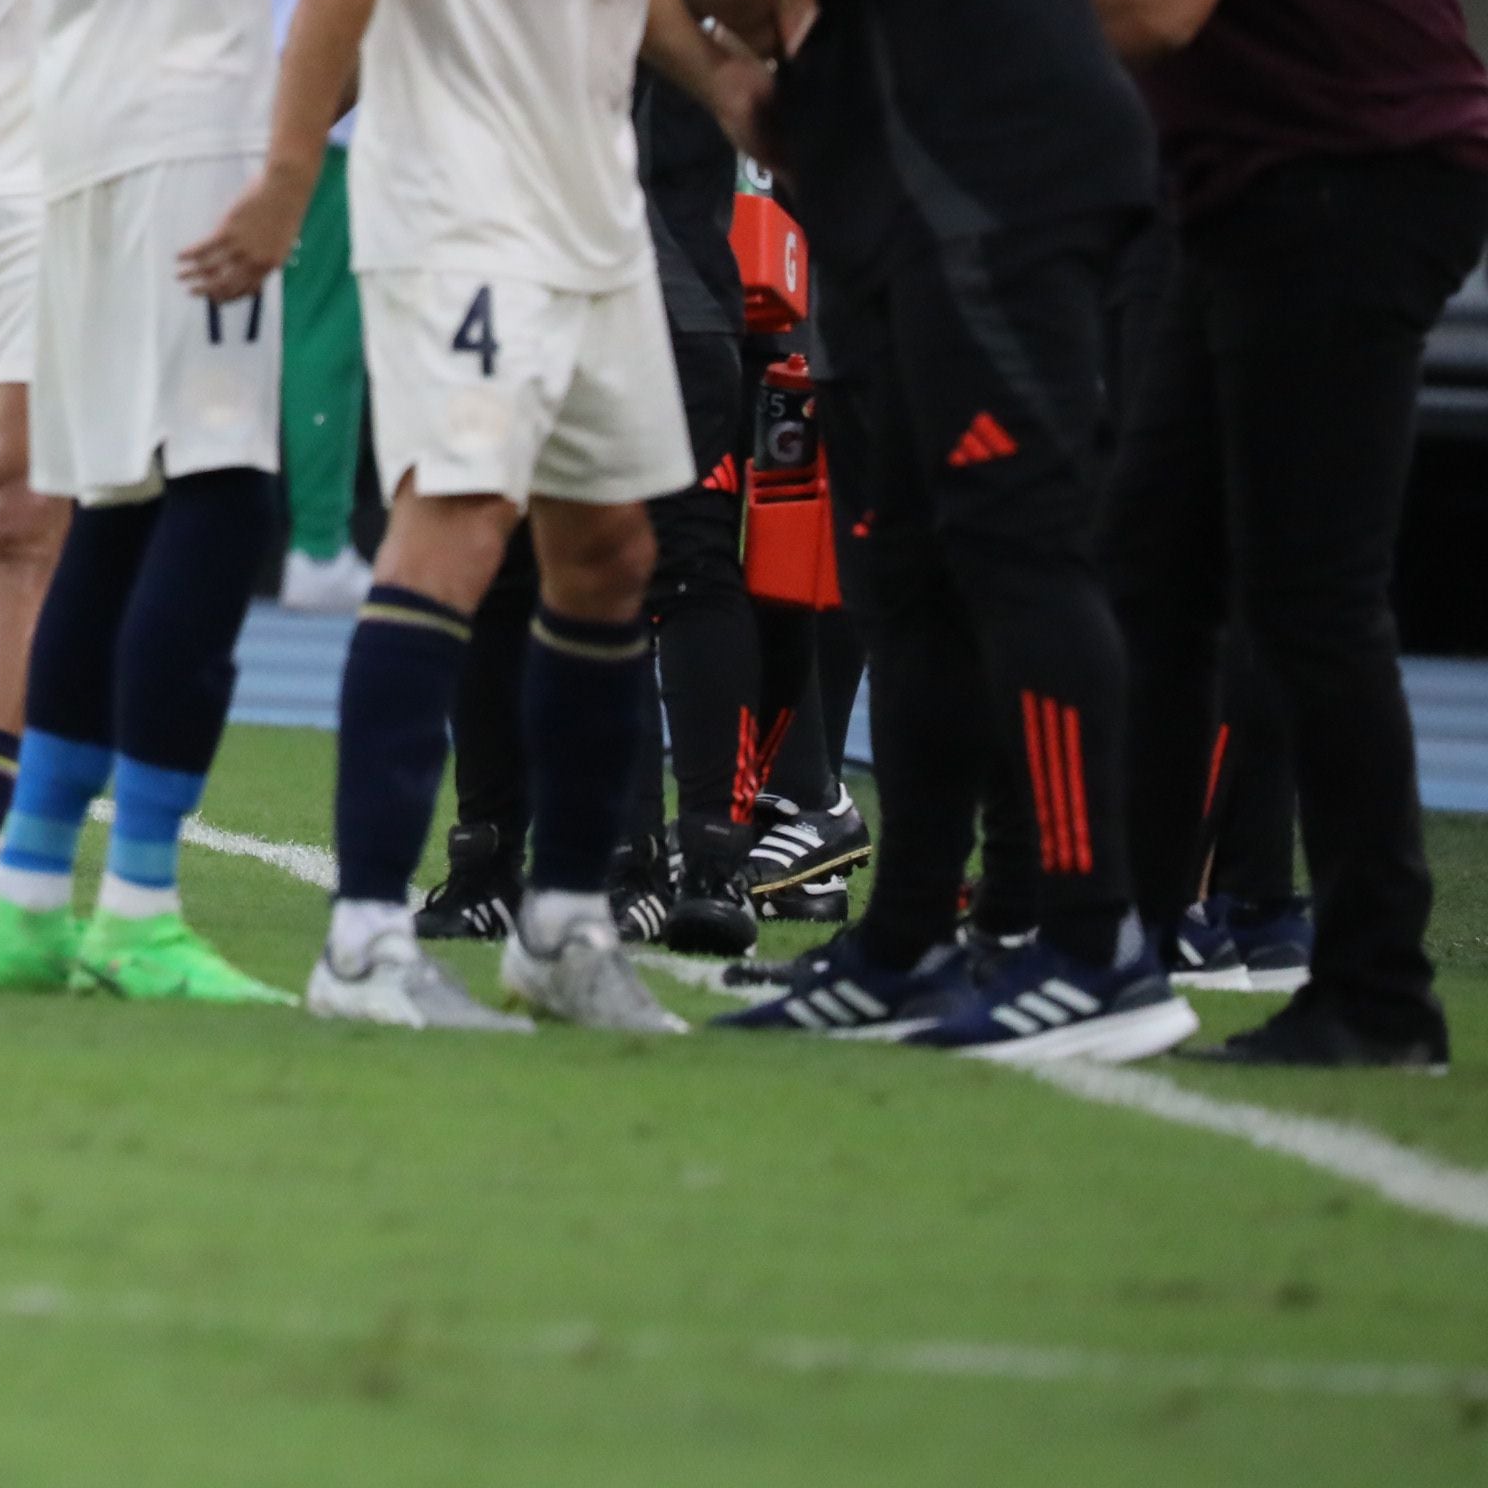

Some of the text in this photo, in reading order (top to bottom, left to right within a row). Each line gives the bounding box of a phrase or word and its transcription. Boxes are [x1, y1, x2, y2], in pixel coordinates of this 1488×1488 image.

[784, 231, 798, 293] G
[452, 285, 499, 377] 4
[768, 420, 805, 464] G
